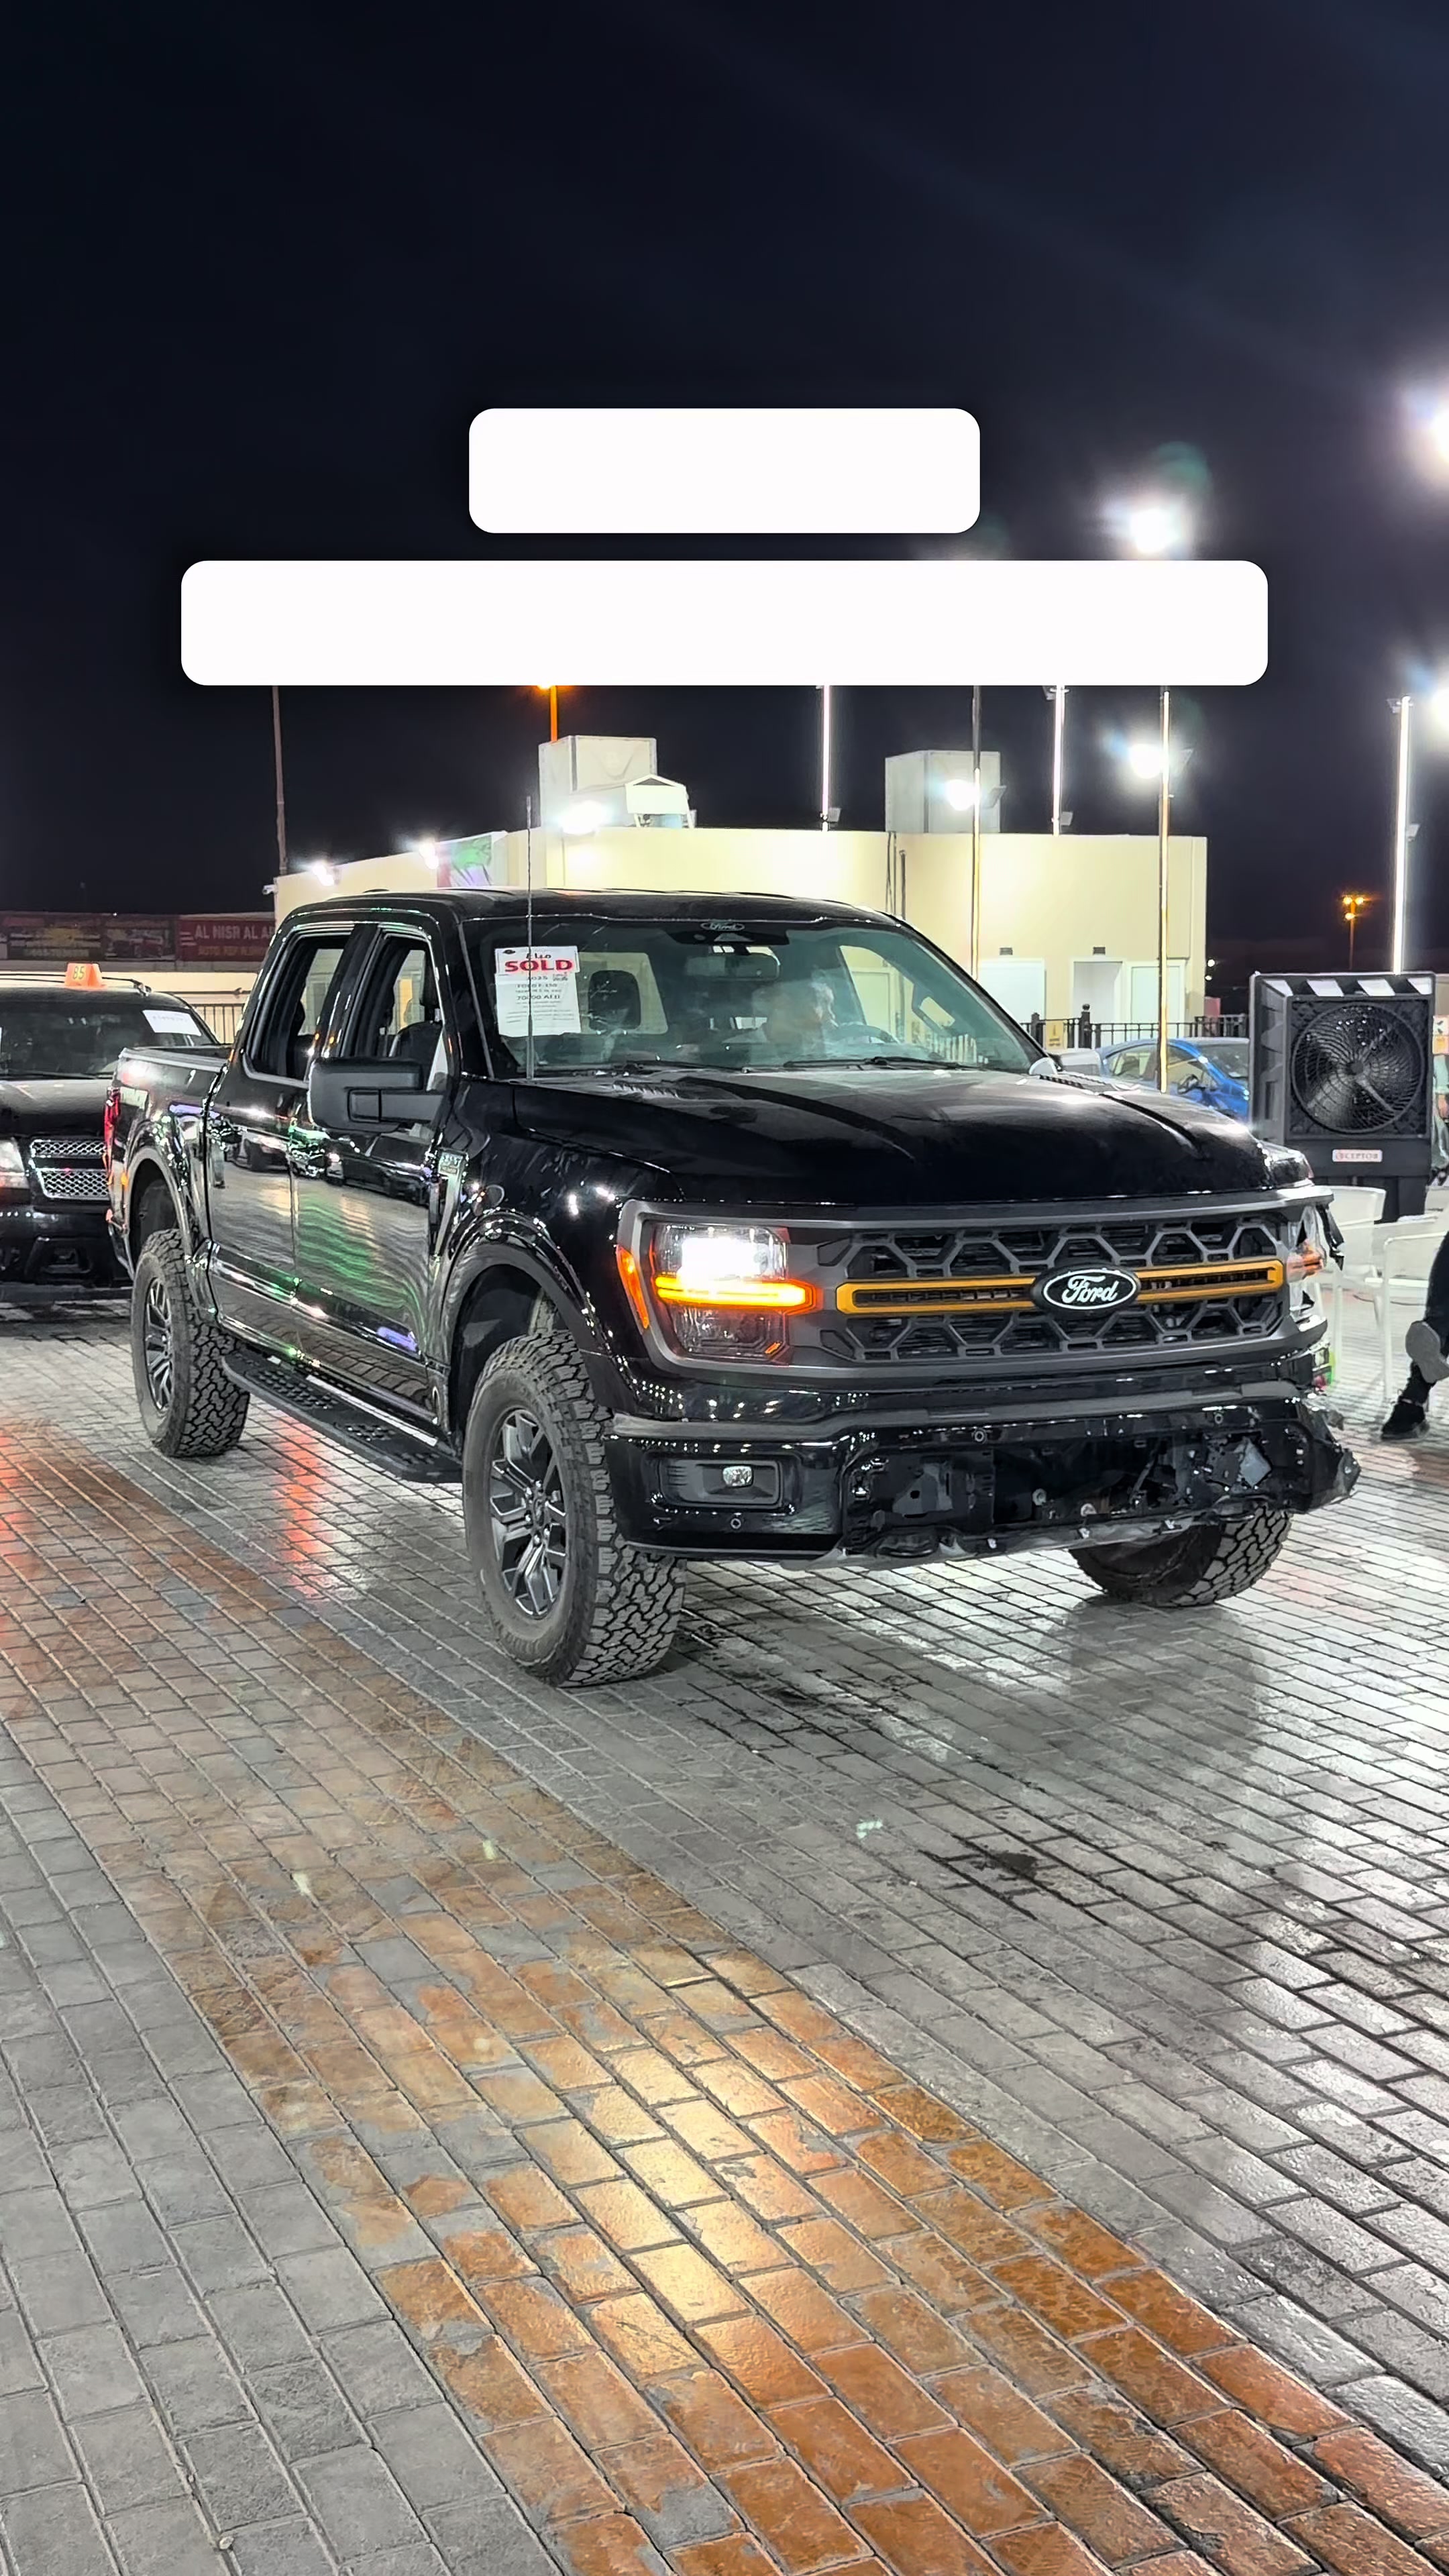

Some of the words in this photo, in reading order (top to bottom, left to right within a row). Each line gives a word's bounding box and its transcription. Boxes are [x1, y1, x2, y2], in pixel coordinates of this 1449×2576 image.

[195, 924, 209, 939] AL
[243, 926, 258, 940] AL
[73, 965, 85, 979] 85
[504, 960, 573, 972] SOLD
[1061, 1275, 1120, 1303] Ford
